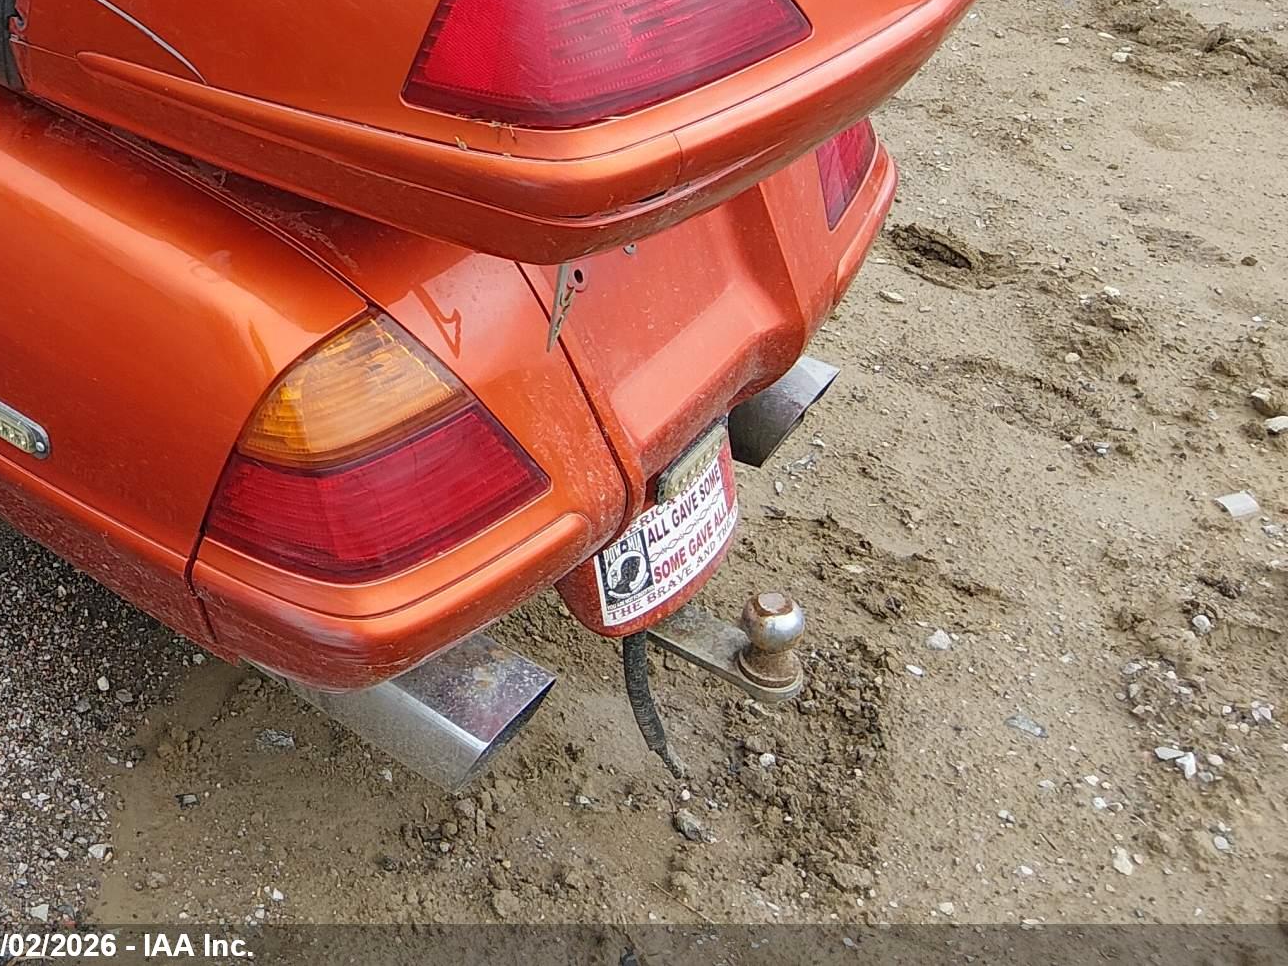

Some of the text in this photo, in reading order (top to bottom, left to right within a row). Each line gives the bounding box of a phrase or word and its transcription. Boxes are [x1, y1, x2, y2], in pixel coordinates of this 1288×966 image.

[648, 518, 671, 547] ALL
[671, 491, 699, 528] GAVE
[699, 462, 722, 502] SOME
[653, 546, 687, 585] SOME
[688, 520, 713, 557] GAVE
[714, 501, 728, 531] ALL
[608, 600, 644, 620] THE
[647, 563, 693, 604] BRAVE
[695, 541, 717, 568] AND
